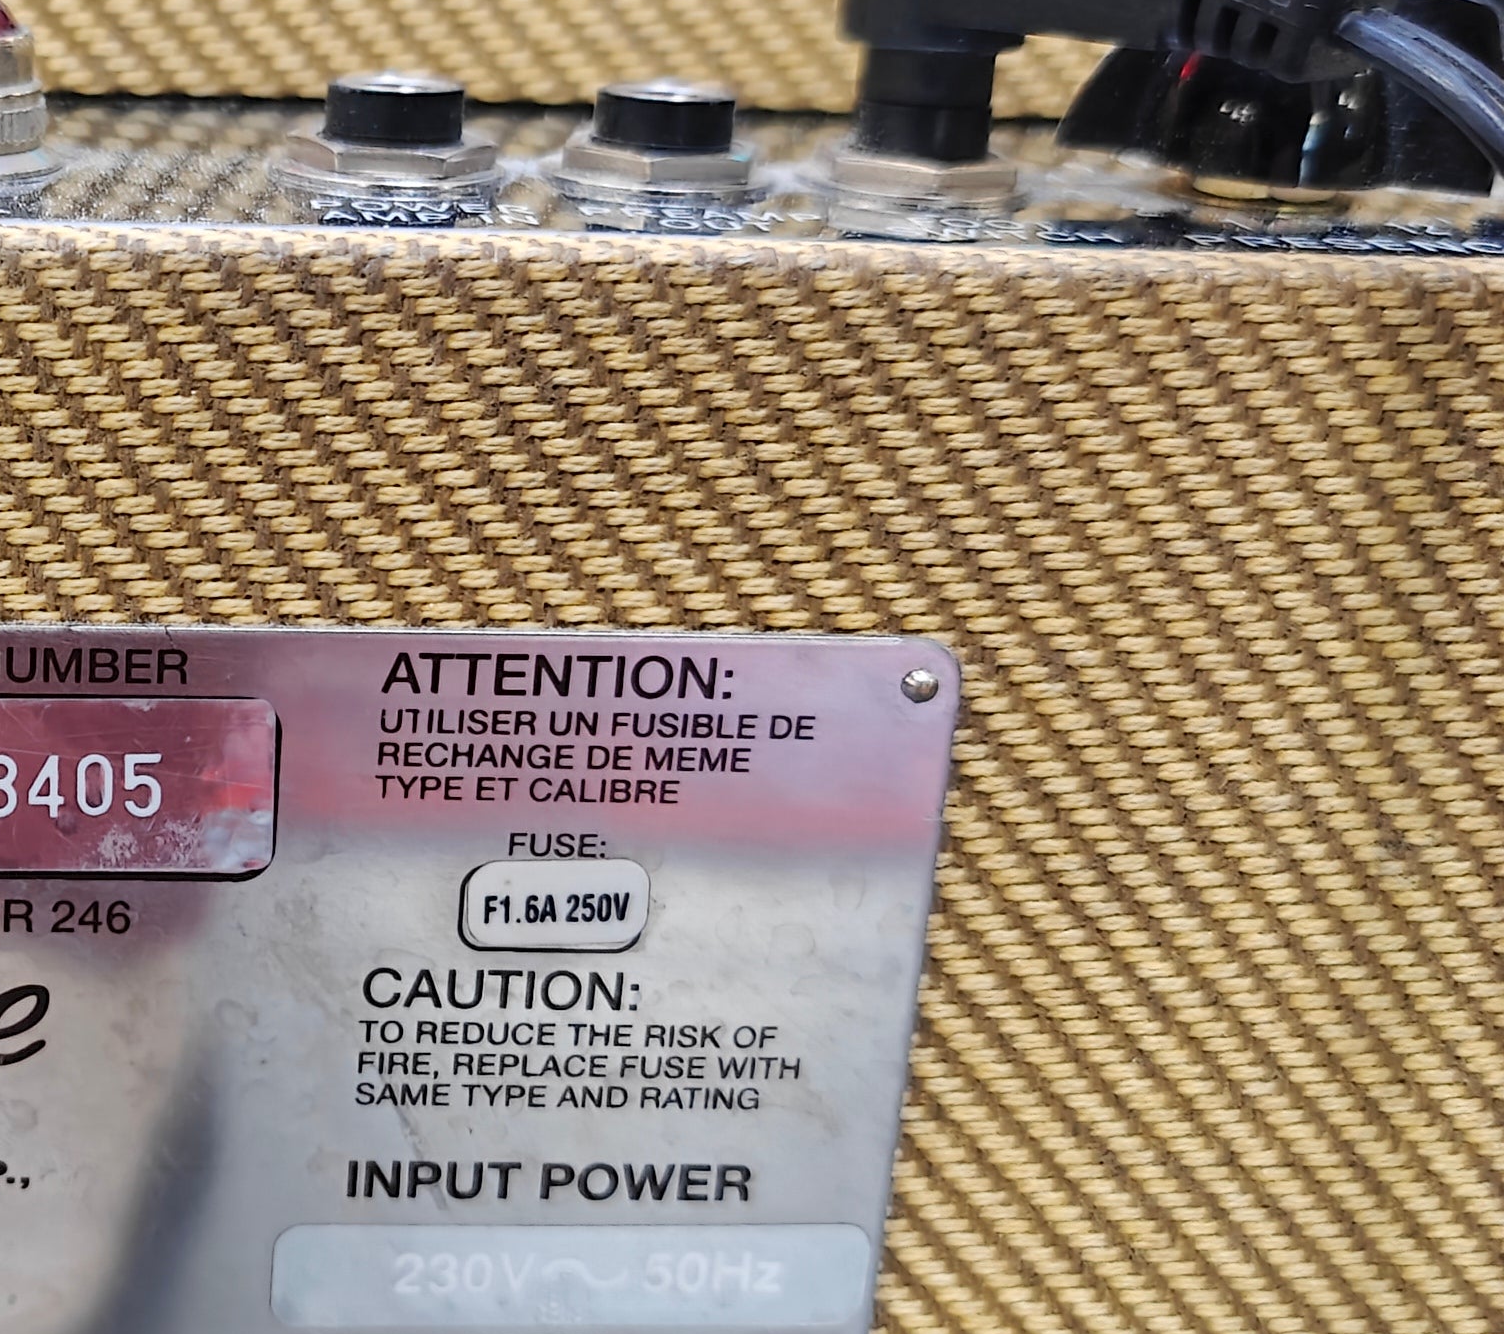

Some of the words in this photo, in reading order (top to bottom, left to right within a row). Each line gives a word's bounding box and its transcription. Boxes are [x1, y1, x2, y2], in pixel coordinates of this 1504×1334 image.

[310, 199, 537, 216] POWER
[323, 210, 452, 224] AMP
[380, 652, 734, 700] ATTENTION:
[380, 708, 537, 736] UTILISER
[549, 711, 598, 737] UN
[611, 712, 758, 740] FUSIBLE
[769, 715, 816, 741] DE
[377, 742, 575, 770] RECHANGE
[587, 745, 633, 771] DE
[644, 747, 752, 773] MEME
[375, 775, 463, 800] TYPE
[476, 776, 518, 801] ET
[529, 778, 680, 804] CALIBRE
[507, 833, 607, 859] FUSE:
[50, 900, 131, 934] 246
[483, 894, 557, 924] F1.6A
[565, 891, 630, 924] 250V
[362, 967, 640, 1012] CAUTION:
[358, 1020, 403, 1046] TO
[416, 1021, 556, 1047] REDUCE
[571, 1024, 633, 1048] THE
[644, 1024, 720, 1050] RISK
[733, 1025, 778, 1050] OF
[357, 1052, 439, 1080] FIRE,
[453, 1054, 607, 1079] REPLACE
[619, 1055, 706, 1080] FUSE
[718, 1056, 801, 1081] WITH
[355, 1083, 451, 1107] SAME
[461, 1084, 549, 1108] TYPE
[556, 1086, 628, 1109] AND
[639, 1086, 760, 1111] RATING
[346, 1161, 522, 1202] INPUT
[539, 1163, 752, 1203] POWER
[642, 1252, 783, 1293] 50Hz
